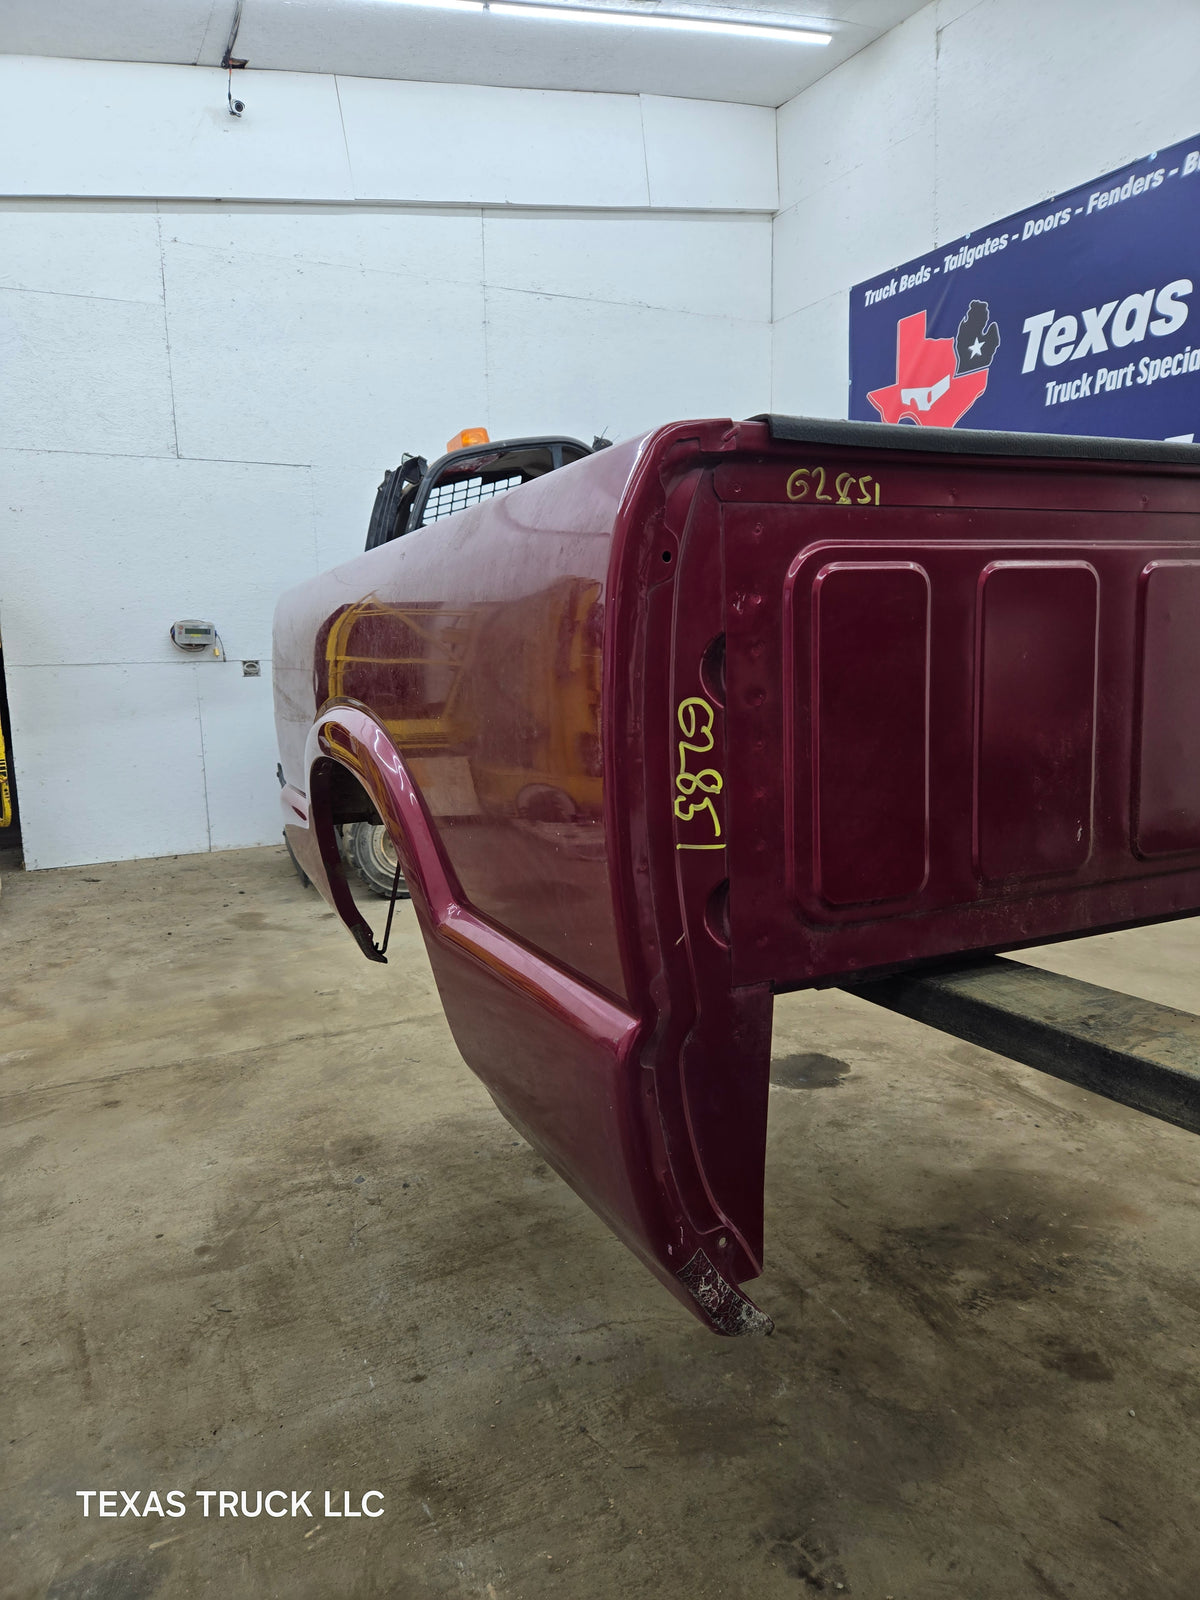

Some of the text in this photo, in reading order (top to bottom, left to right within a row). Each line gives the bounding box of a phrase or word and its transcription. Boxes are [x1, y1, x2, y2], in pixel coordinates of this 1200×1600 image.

[864, 279, 897, 307] Truck
[899, 265, 931, 293] Beds
[943, 232, 1009, 273] Tailgates
[1022, 206, 1072, 241] Doors
[1086, 166, 1165, 215] Fenders
[1021, 278, 1194, 374] Texas
[1045, 370, 1091, 406] Truck
[1094, 362, 1136, 395] Part
